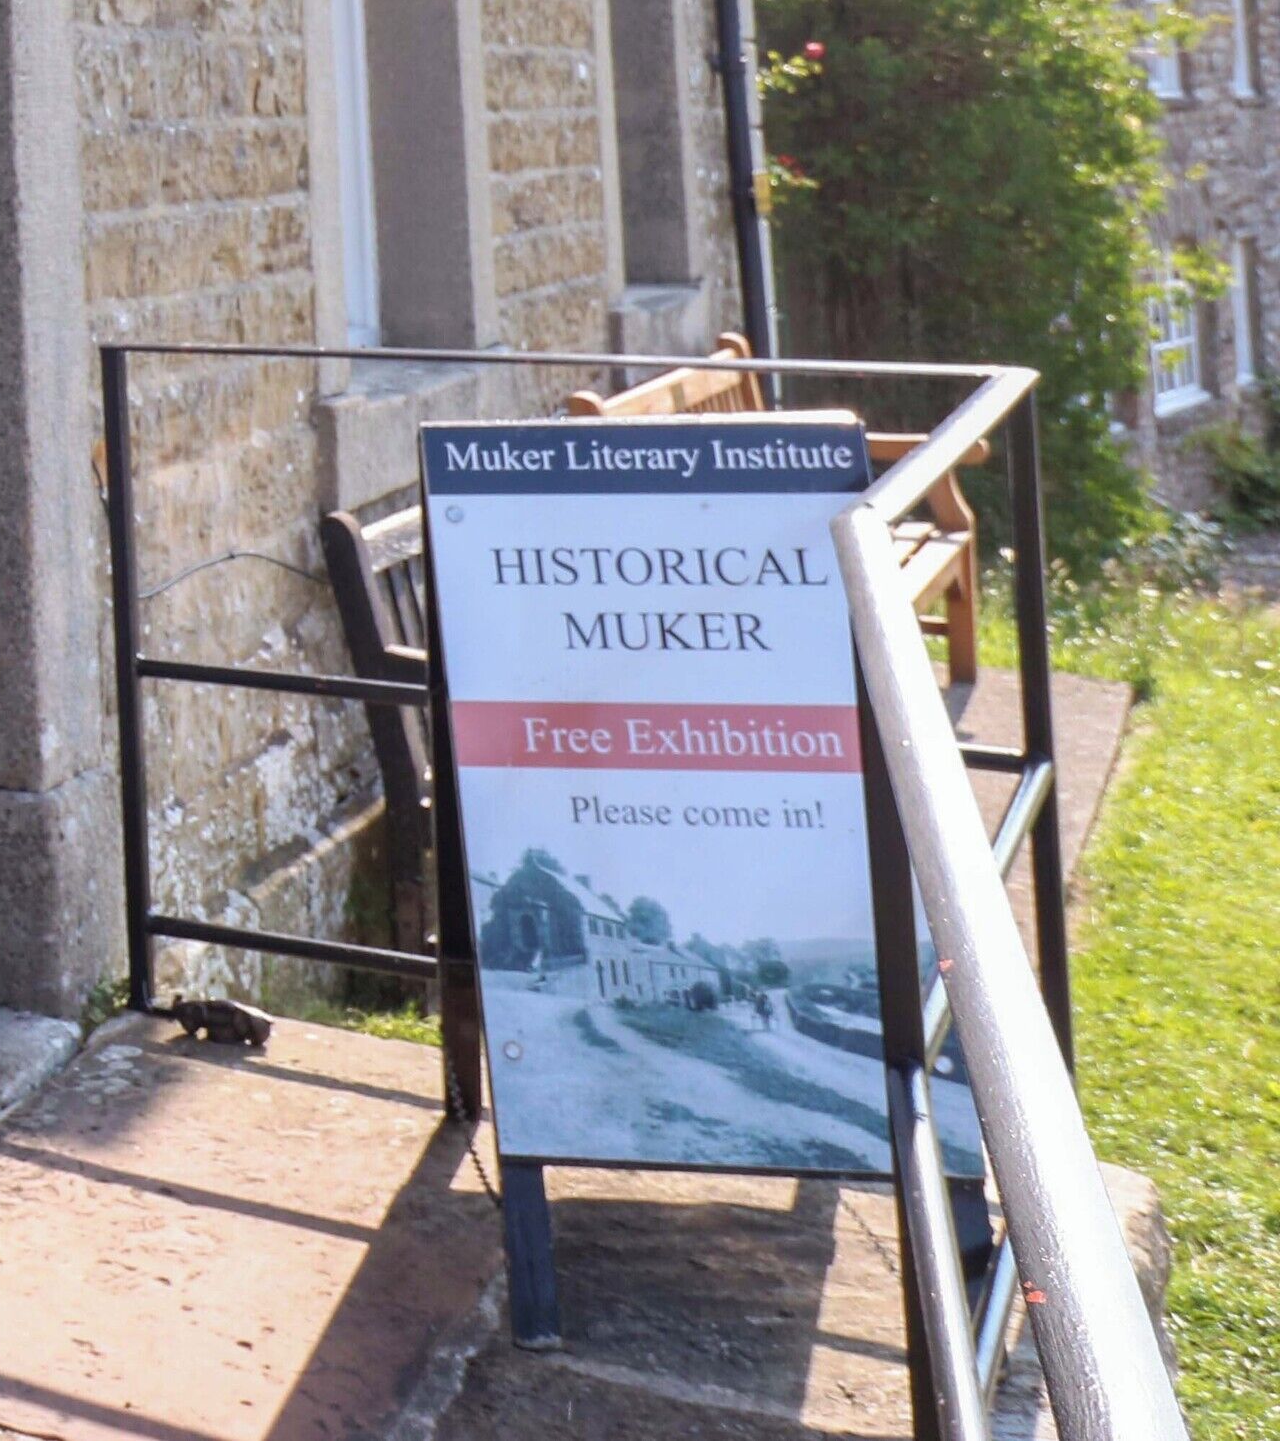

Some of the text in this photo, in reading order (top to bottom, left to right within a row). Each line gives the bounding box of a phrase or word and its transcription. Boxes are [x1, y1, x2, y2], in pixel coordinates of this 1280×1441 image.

[446, 439, 852, 473] Muker Literary Institute
[492, 546, 829, 587] HISTORICAL
[562, 612, 771, 651] MUKER
[523, 716, 844, 758] Free Exhibition
[570, 795, 825, 829] Please come in!
